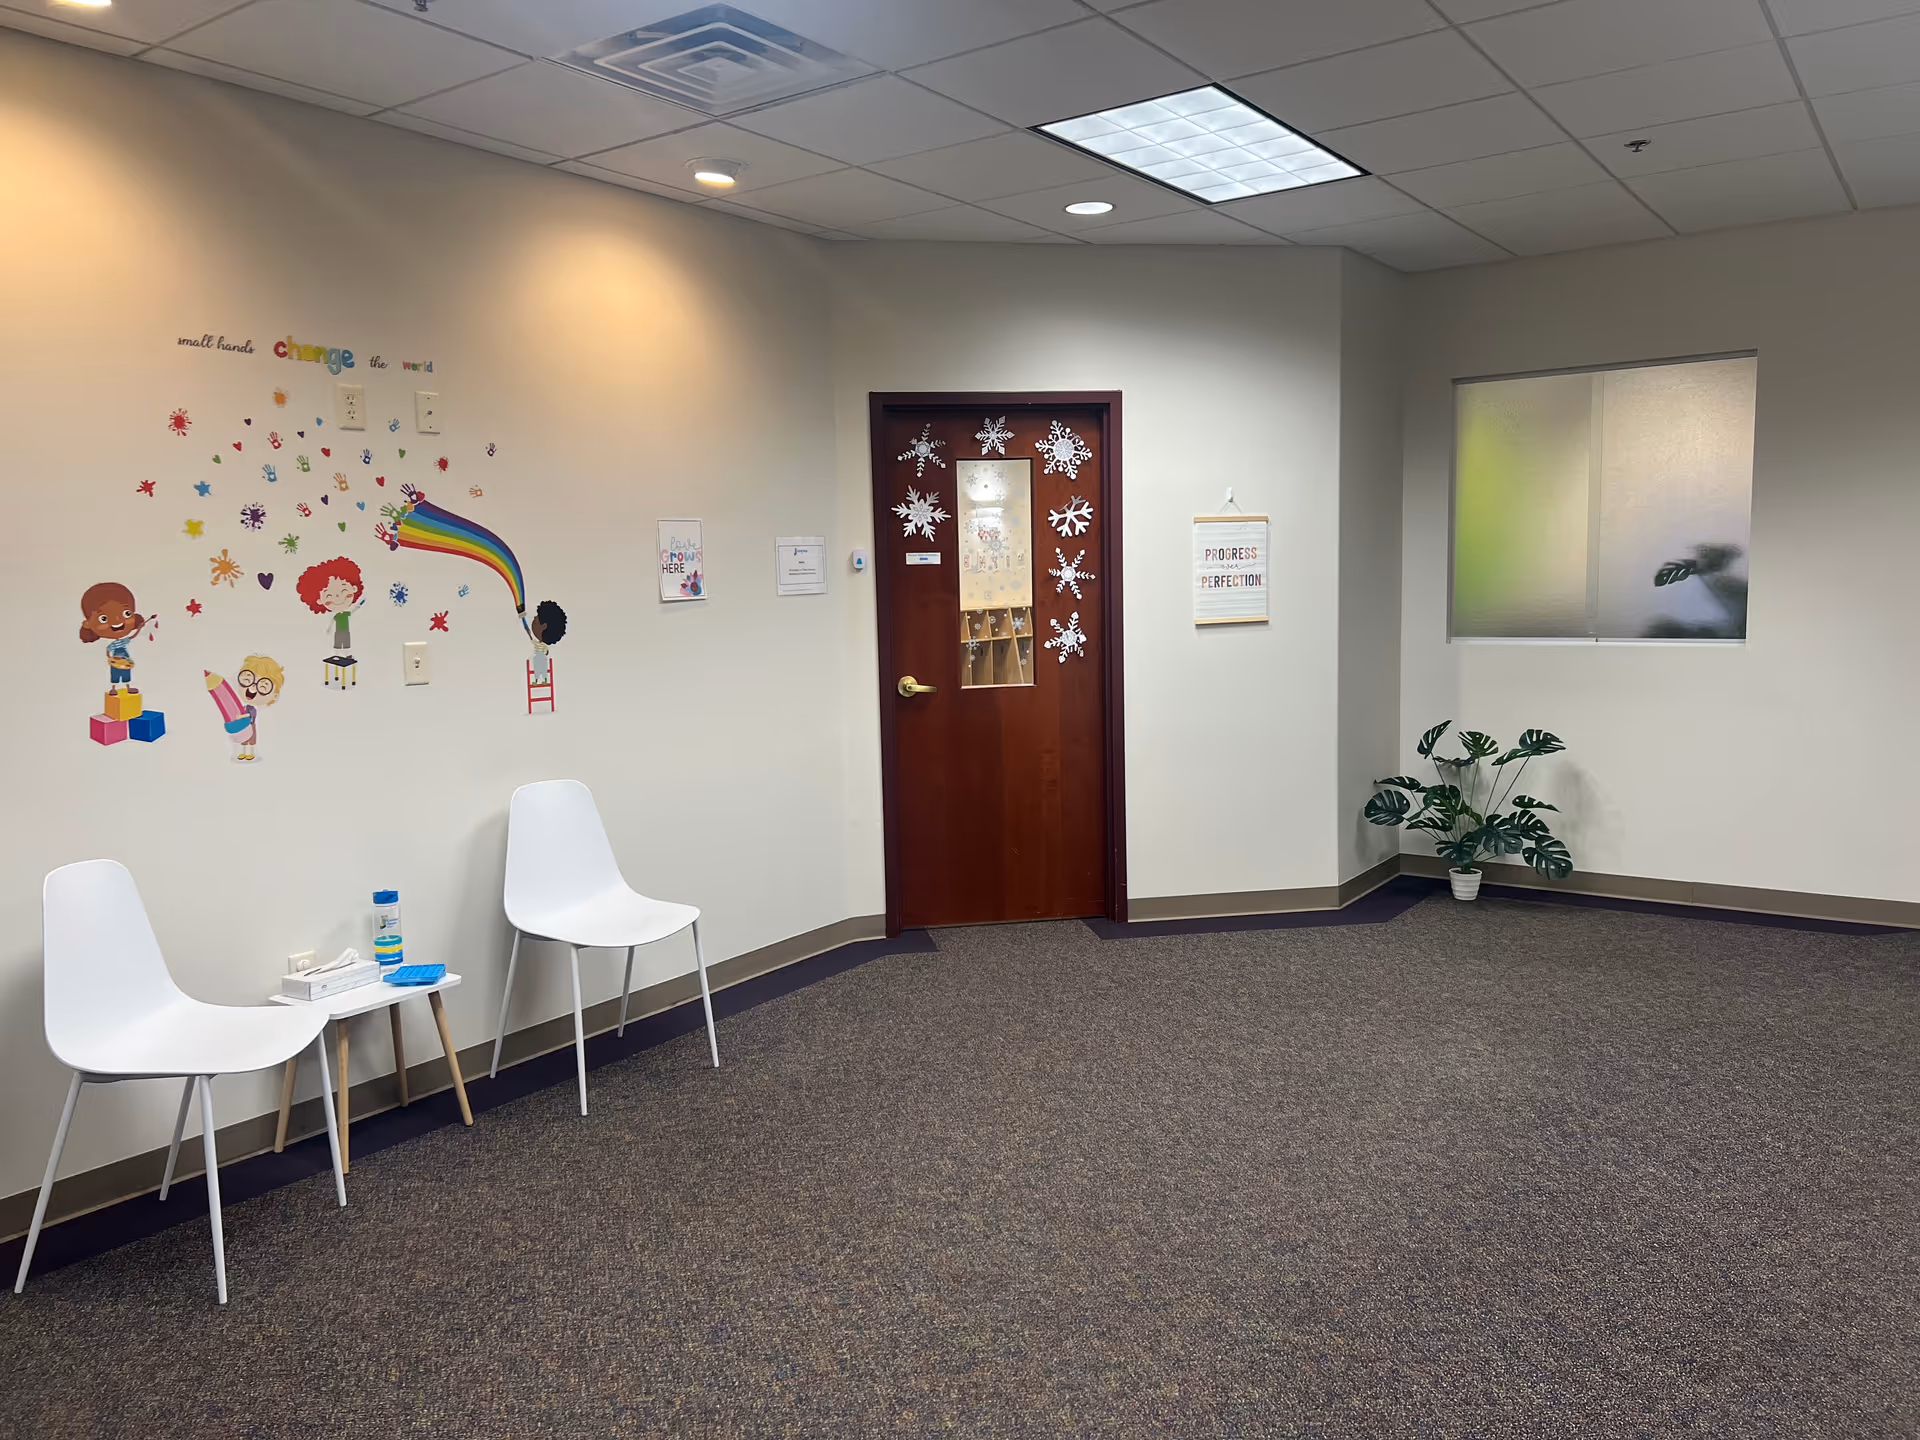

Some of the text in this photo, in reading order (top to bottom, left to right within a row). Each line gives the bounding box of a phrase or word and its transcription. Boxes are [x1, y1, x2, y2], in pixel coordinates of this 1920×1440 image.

[177, 333, 433, 375] small hands change the world
[1205, 547, 1257, 561] PROGRESS
[662, 563, 685, 574] HERE
[1201, 573, 1262, 588] PERFECTION
